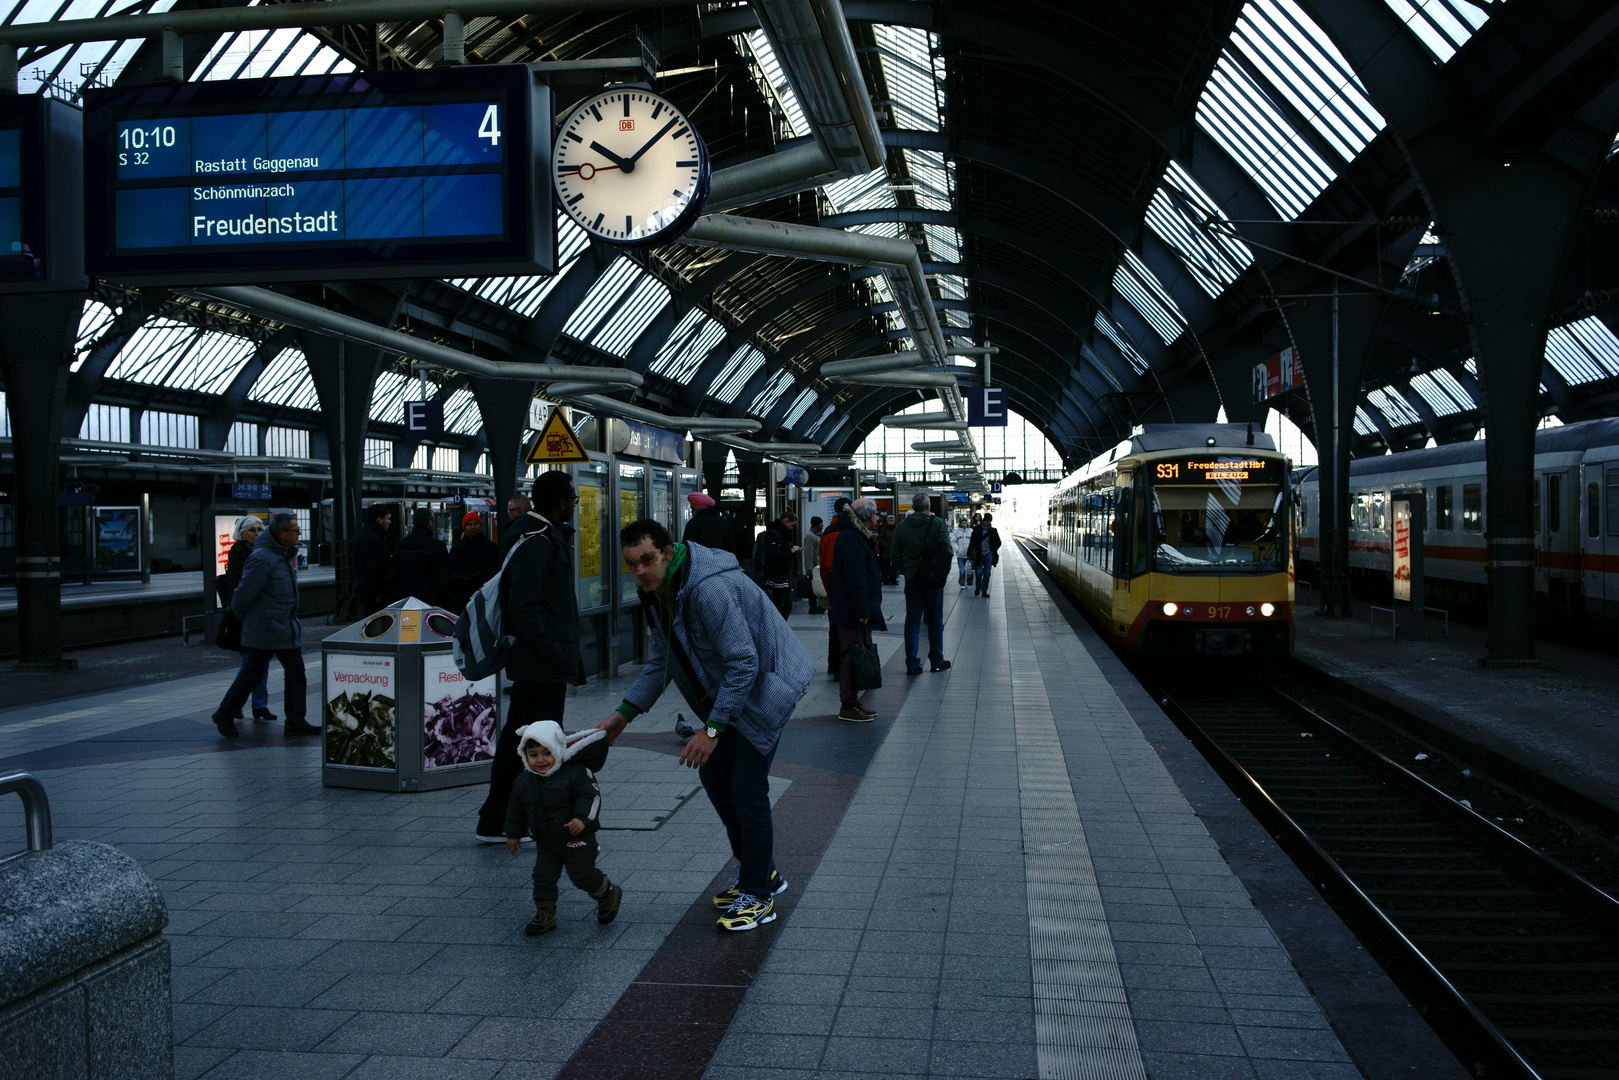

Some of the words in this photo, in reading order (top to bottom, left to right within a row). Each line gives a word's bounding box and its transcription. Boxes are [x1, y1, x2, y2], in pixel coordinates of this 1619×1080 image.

[477, 104, 502, 146] 4
[620, 121, 633, 130] DB
[119, 126, 176, 149] 10:10
[119, 153, 128, 166] S
[133, 152, 150, 165] 32
[195, 158, 247, 173] Rastatt
[253, 157, 319, 173] Gaggenau
[193, 184, 295, 201] Schönmünzach
[193, 210, 338, 237] Freudenstadt
[983, 387, 1003, 418] E
[408, 402, 427, 431] E
[1157, 463, 1179, 478] S31
[1188, 461, 1248, 470] Freudenstadt
[1249, 460, 1266, 470] Hbf
[994, 482, 1001, 492] D
[454, 495, 461, 503] D
[1208, 605, 1232, 619] 917
[333, 670, 389, 687] Verpackung
